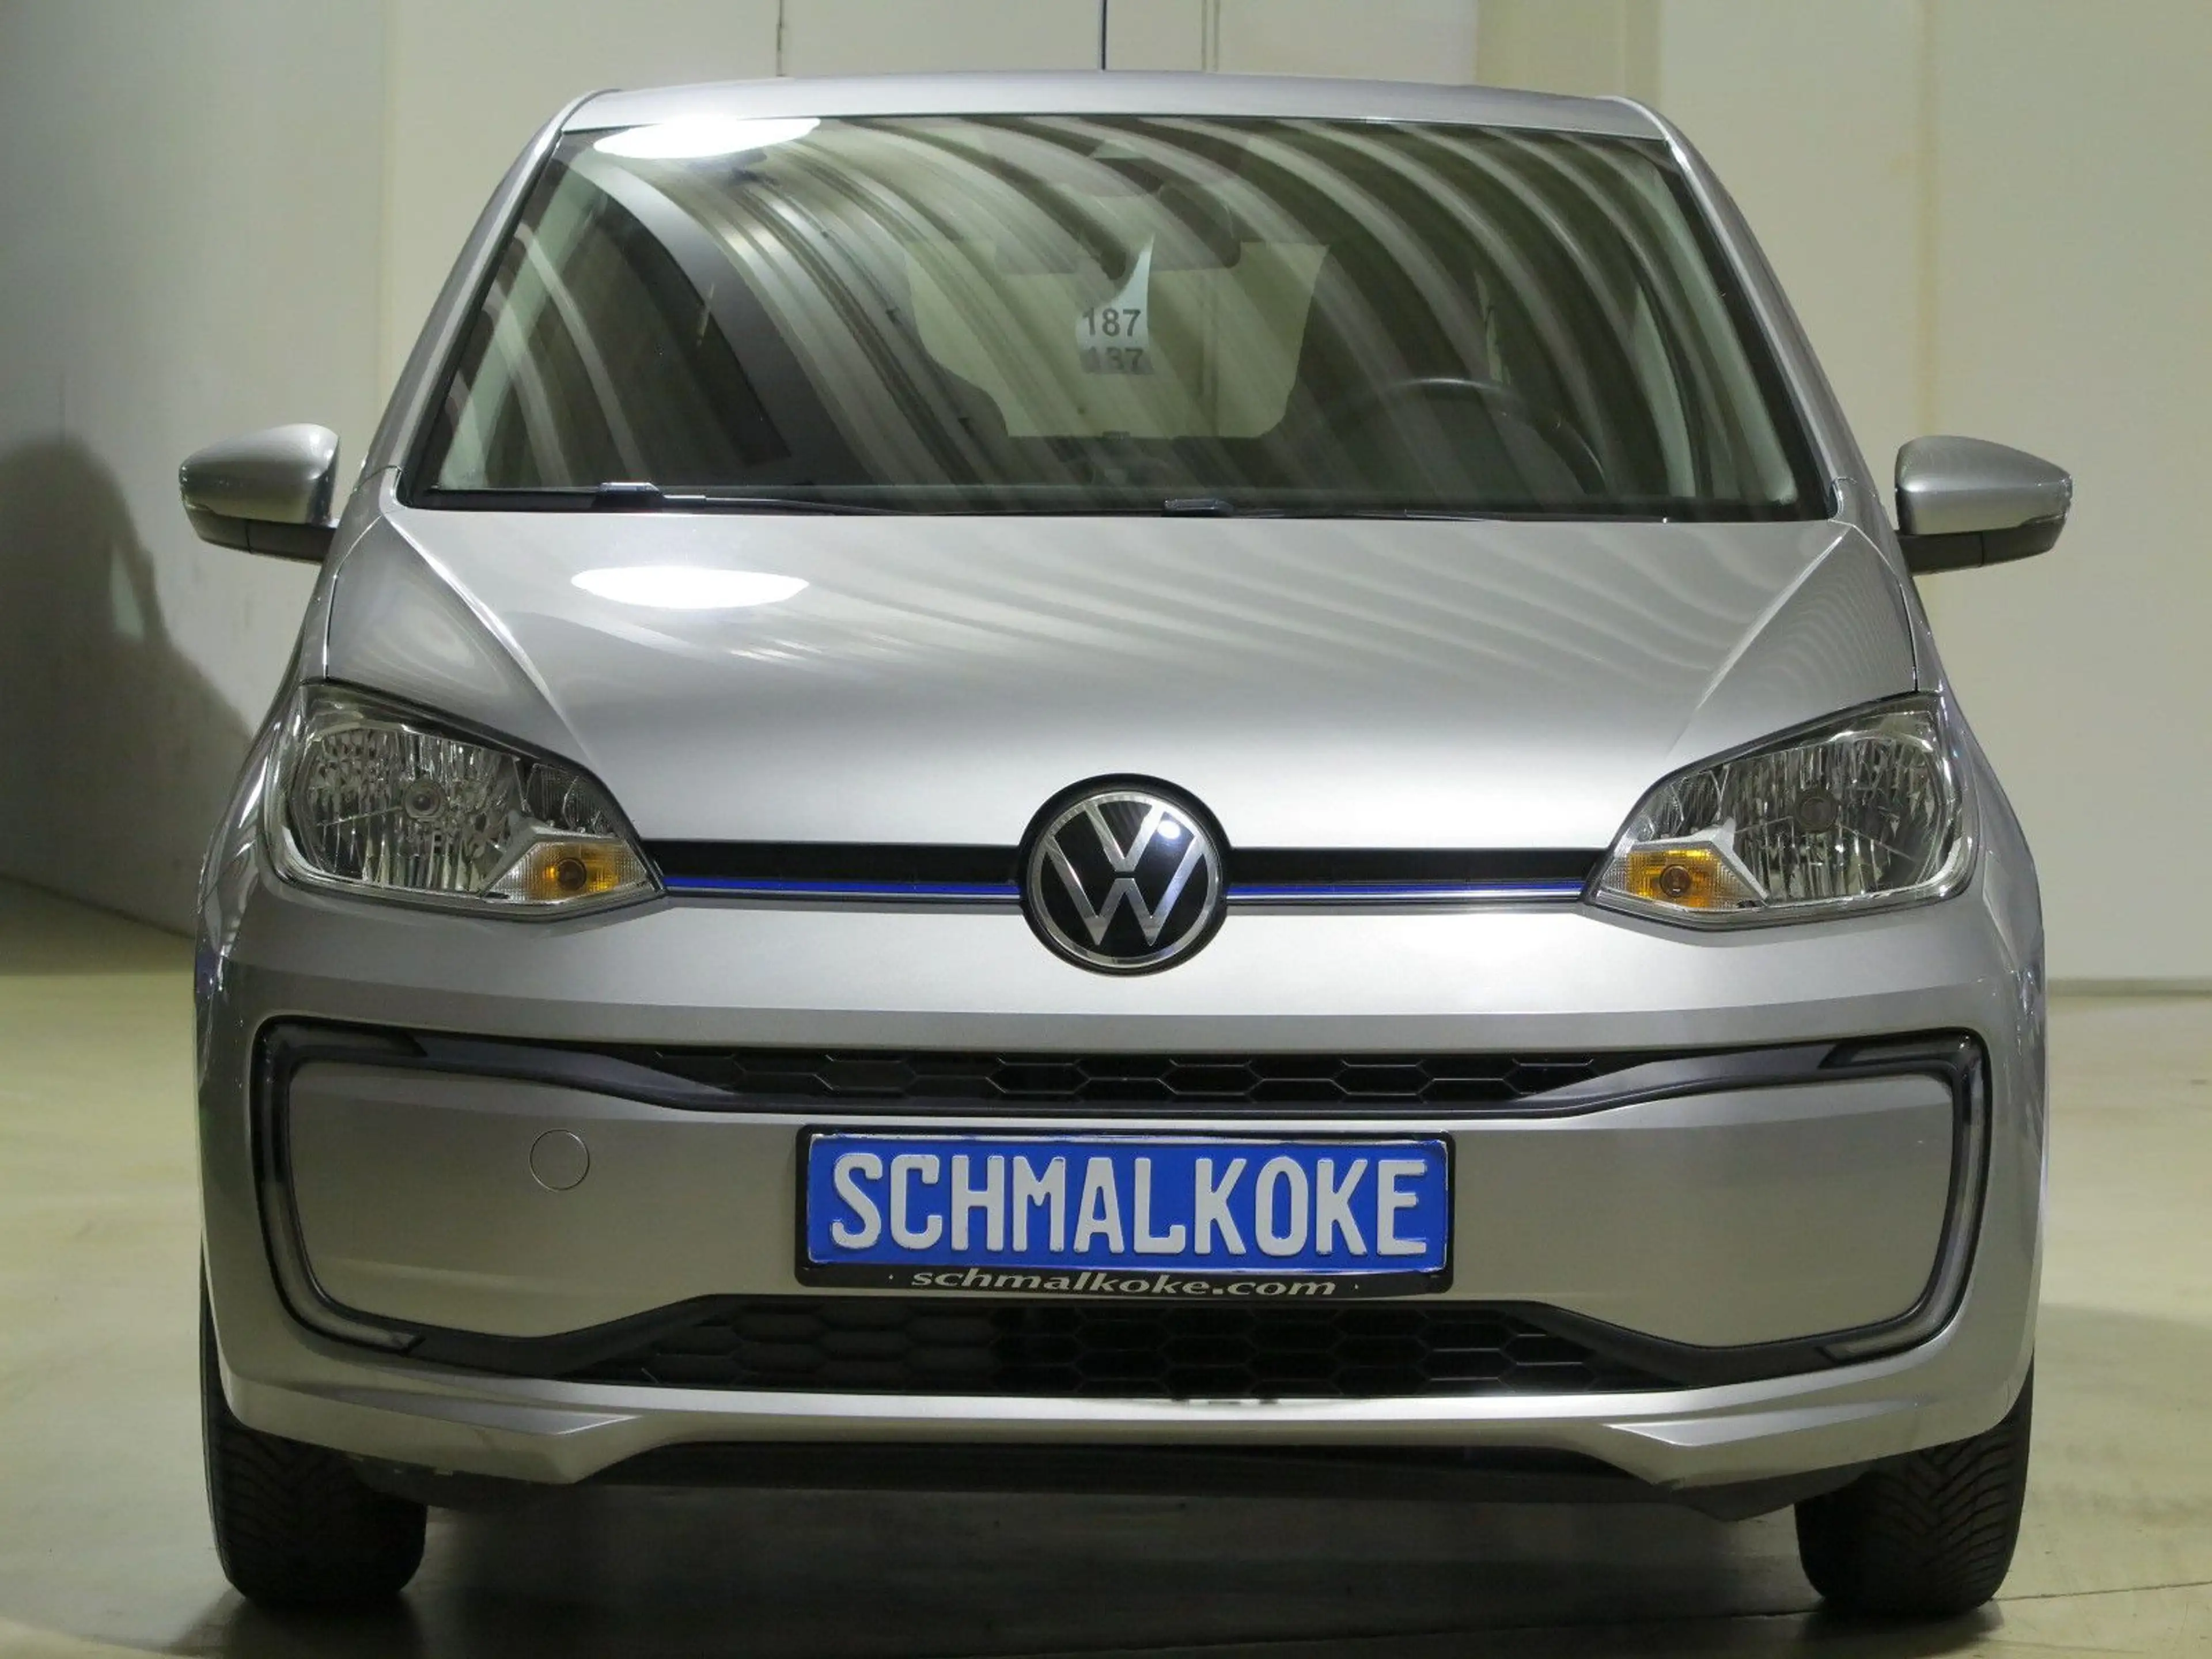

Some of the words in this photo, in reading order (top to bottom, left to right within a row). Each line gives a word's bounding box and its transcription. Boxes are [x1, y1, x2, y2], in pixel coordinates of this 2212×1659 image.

[1082, 307, 1141, 337] 187
[1040, 798, 1209, 949] VW
[830, 1152, 1429, 1257] SCHMALKOKE
[911, 1268, 1336, 1297] schmalkoke.com
